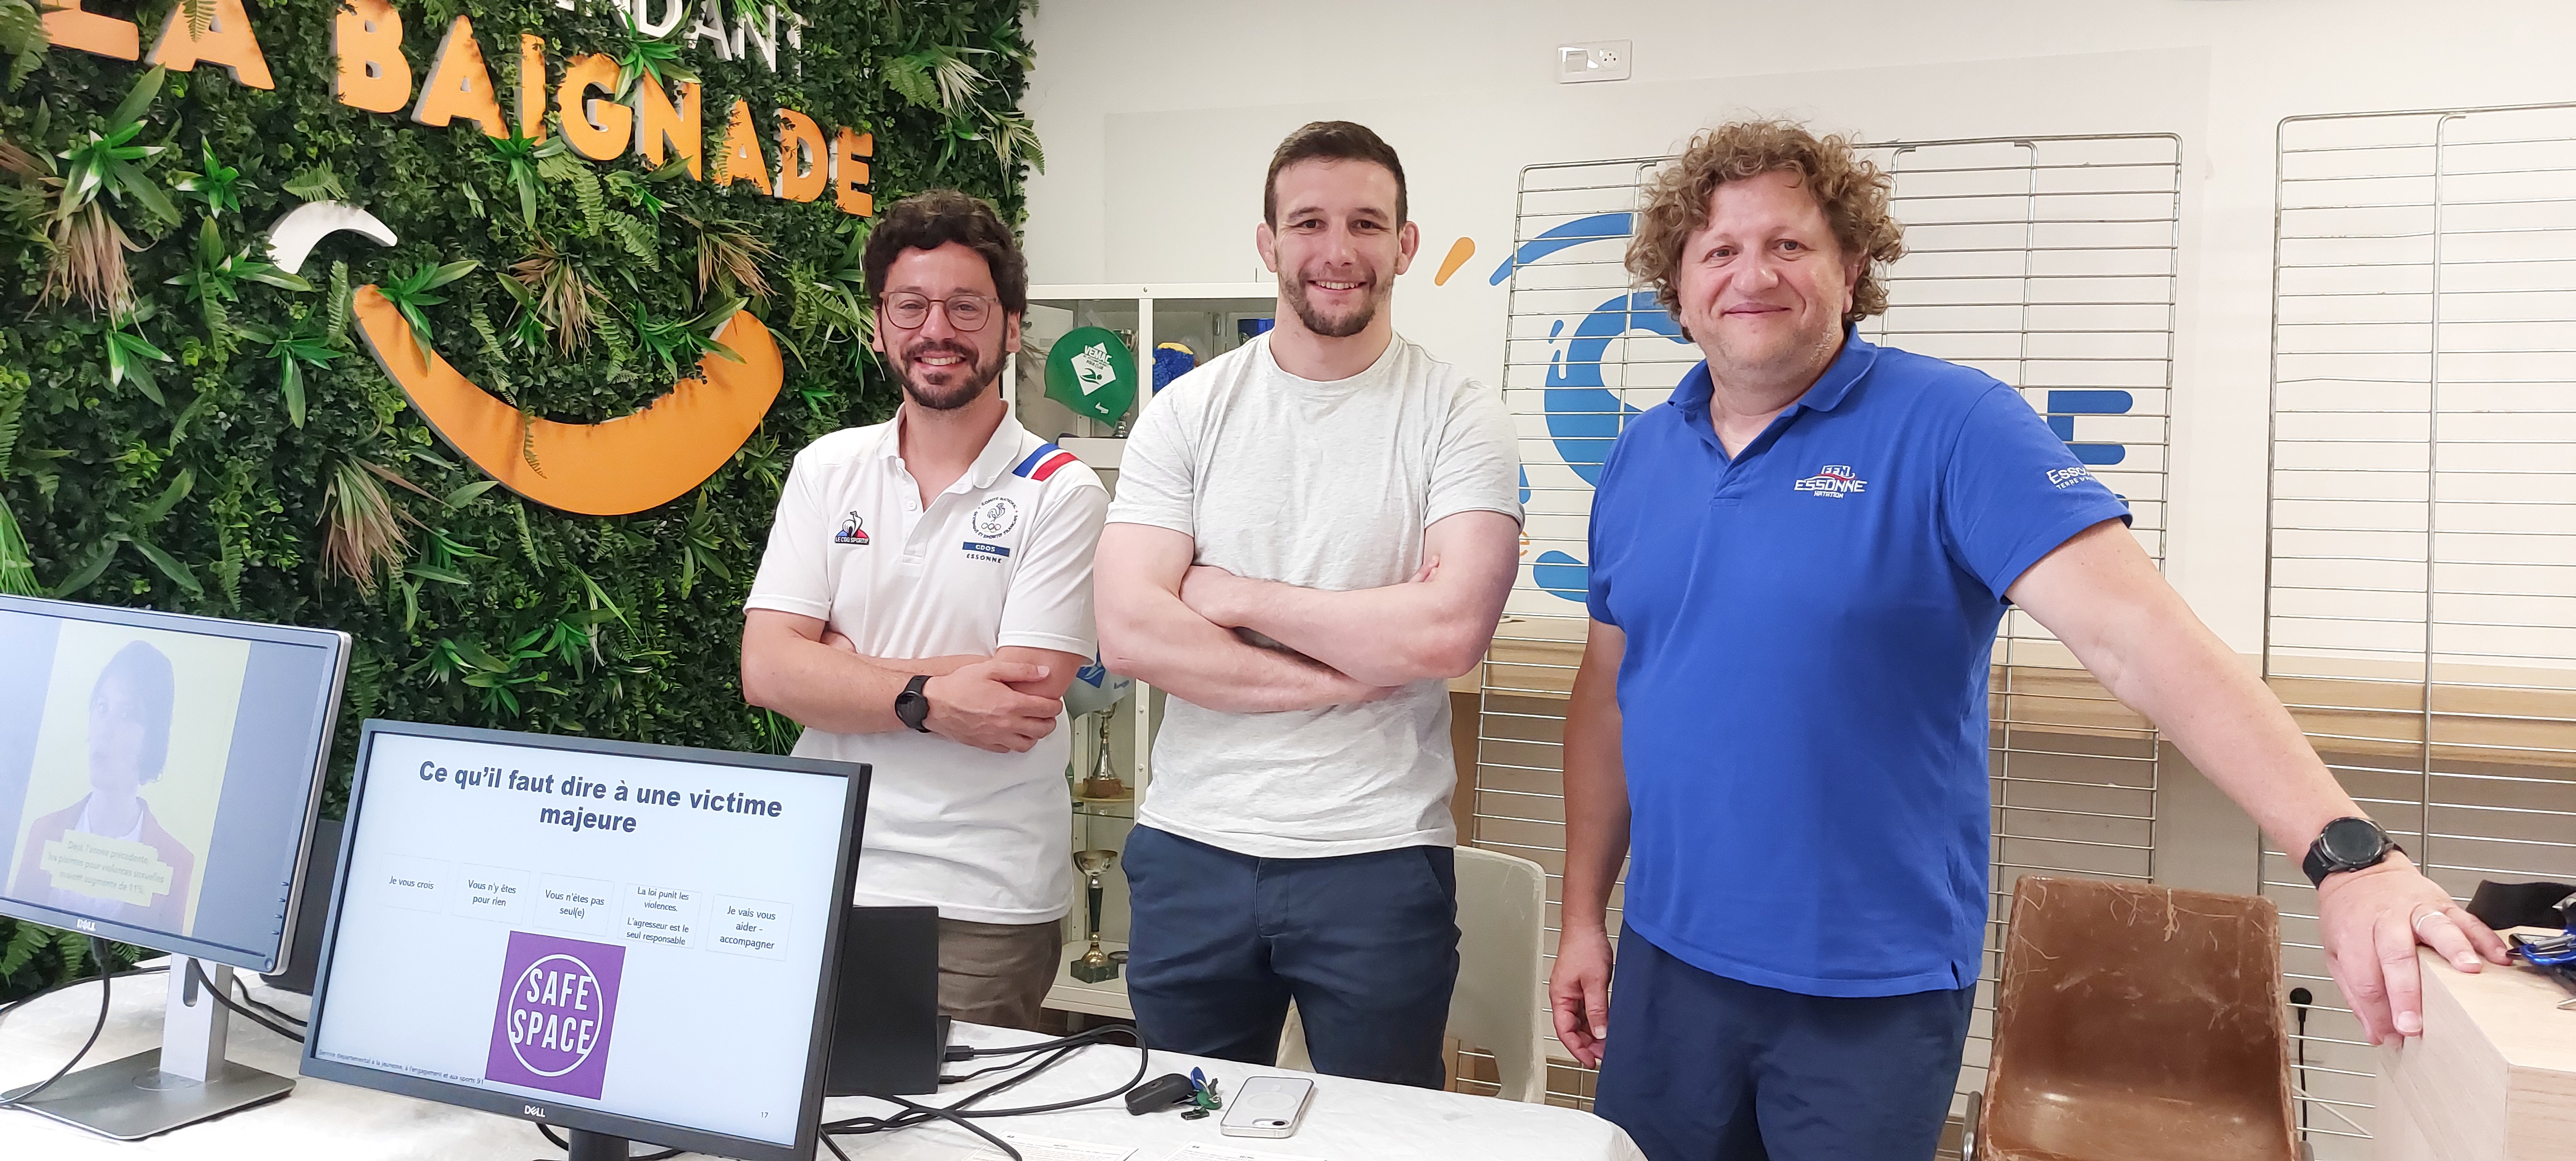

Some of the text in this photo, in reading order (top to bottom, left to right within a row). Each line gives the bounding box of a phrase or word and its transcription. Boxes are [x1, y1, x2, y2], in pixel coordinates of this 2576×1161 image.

[42, 0, 873, 217] LA BAIGNADE
[1084, 345, 1113, 364] VEMAC
[1794, 479, 1867, 492] ESSONNE
[2056, 477, 2079, 490] TERRE
[966, 553, 1002, 564] ESSONNE
[419, 760, 782, 817] Ce qu'il faut dire à une victime
[540, 806, 637, 832] majeure
[48, 852, 57, 861] les
[102, 864, 133, 876] violences
[133, 870, 165, 883] sexuelles
[118, 881, 127, 891] de
[389, 876, 434, 890] Je vous crois
[468, 879, 516, 894] Vous n'y êtes
[545, 889, 605, 907] Vous n'êtes pas
[637, 886, 689, 900] La loi punit les
[472, 895, 506, 906] pour rien
[644, 900, 678, 912] violences.
[559, 907, 585, 919] seul(e)
[727, 905, 776, 920] Je vais vous
[76, 918, 96, 932] DELL
[627, 917, 689, 933] L'agresseur est le
[735, 921, 757, 932] aider
[626, 930, 686, 945] seul responsable
[719, 936, 775, 950] accompagner
[526, 968, 592, 1011] SAFE
[511, 1008, 594, 1055] SPACE
[524, 1105, 546, 1118] DELL
